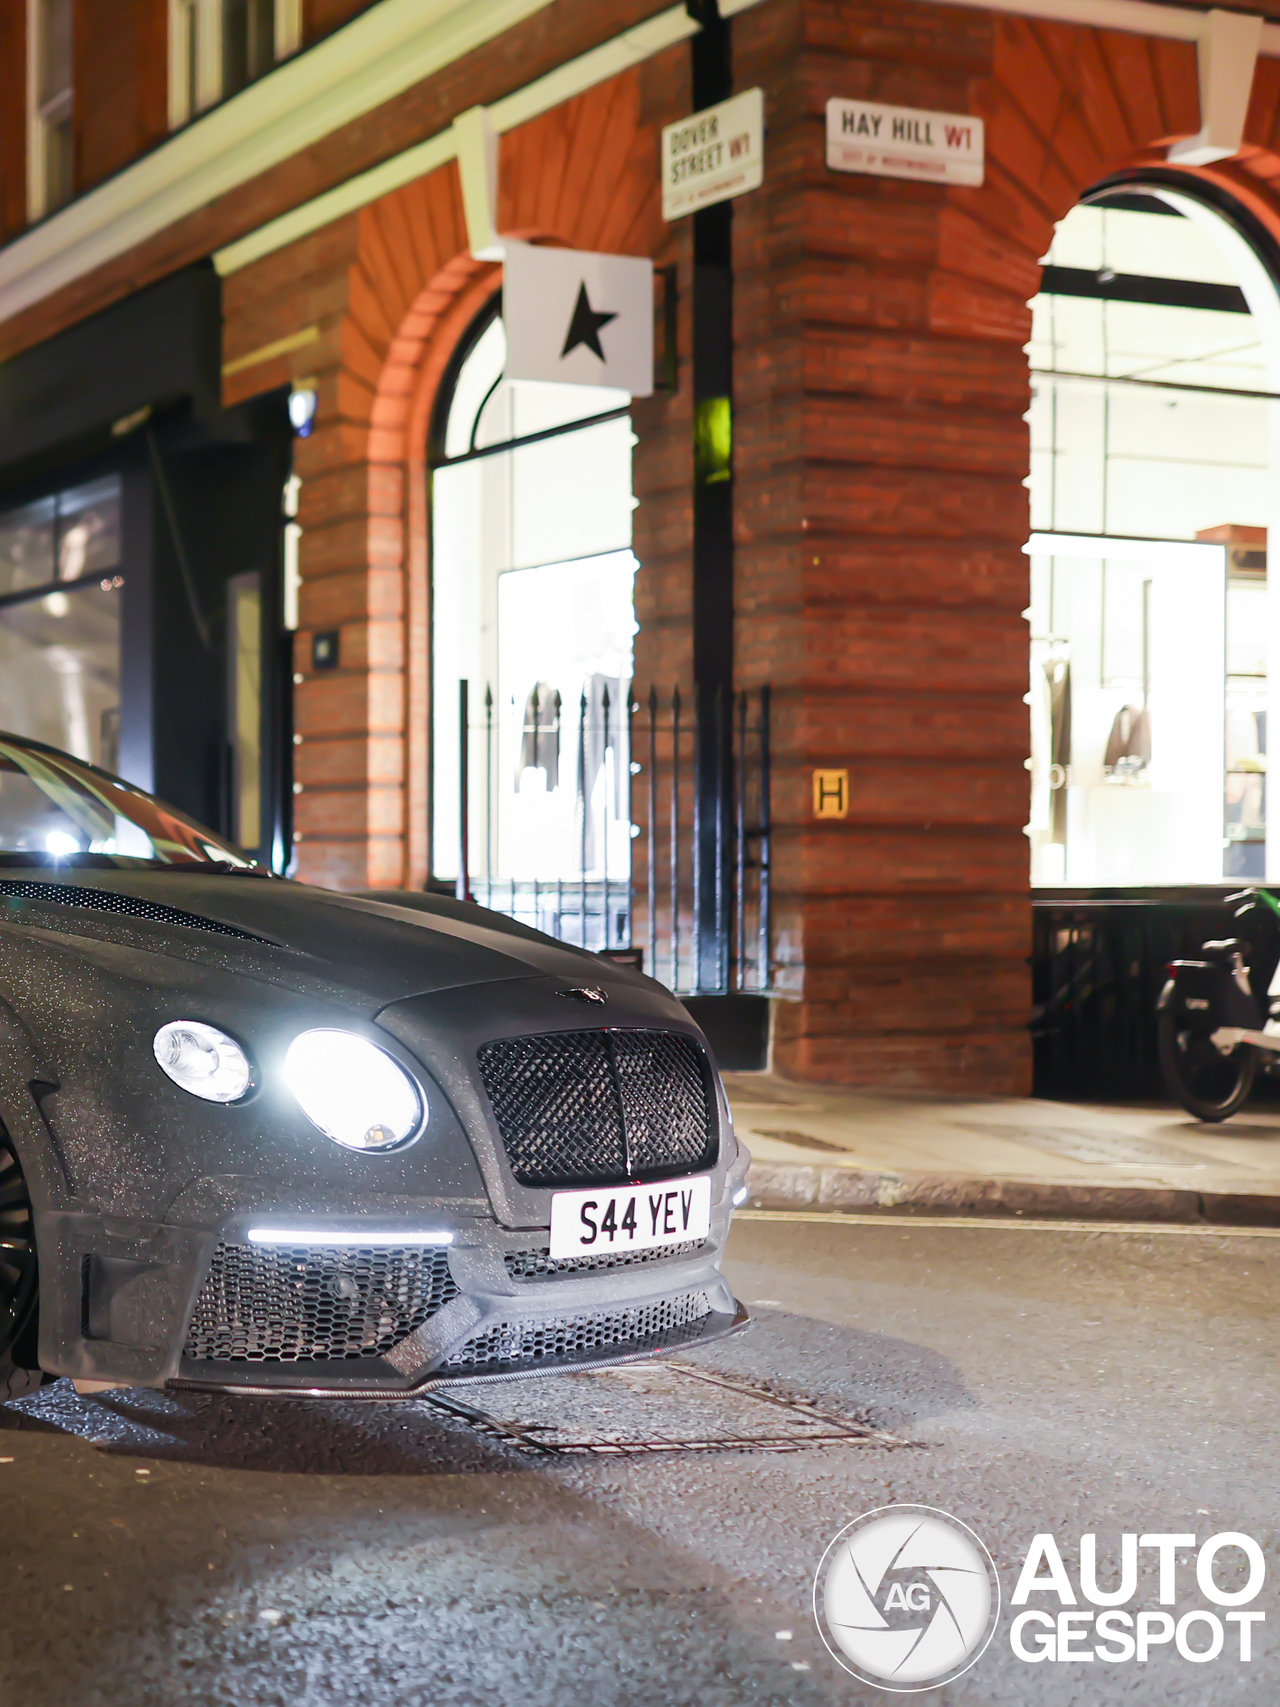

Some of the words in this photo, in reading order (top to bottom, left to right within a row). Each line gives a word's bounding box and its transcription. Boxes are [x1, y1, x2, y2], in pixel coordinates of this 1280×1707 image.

[670, 115, 718, 156] DOVER
[842, 110, 882, 137] HAY
[892, 116, 935, 146] HILL
[944, 123, 972, 150] W1
[671, 142, 723, 185] STREET
[729, 132, 750, 160] W1
[820, 776, 842, 811] H
[579, 1197, 637, 1245] S44
[649, 1189, 693, 1236] YEV
